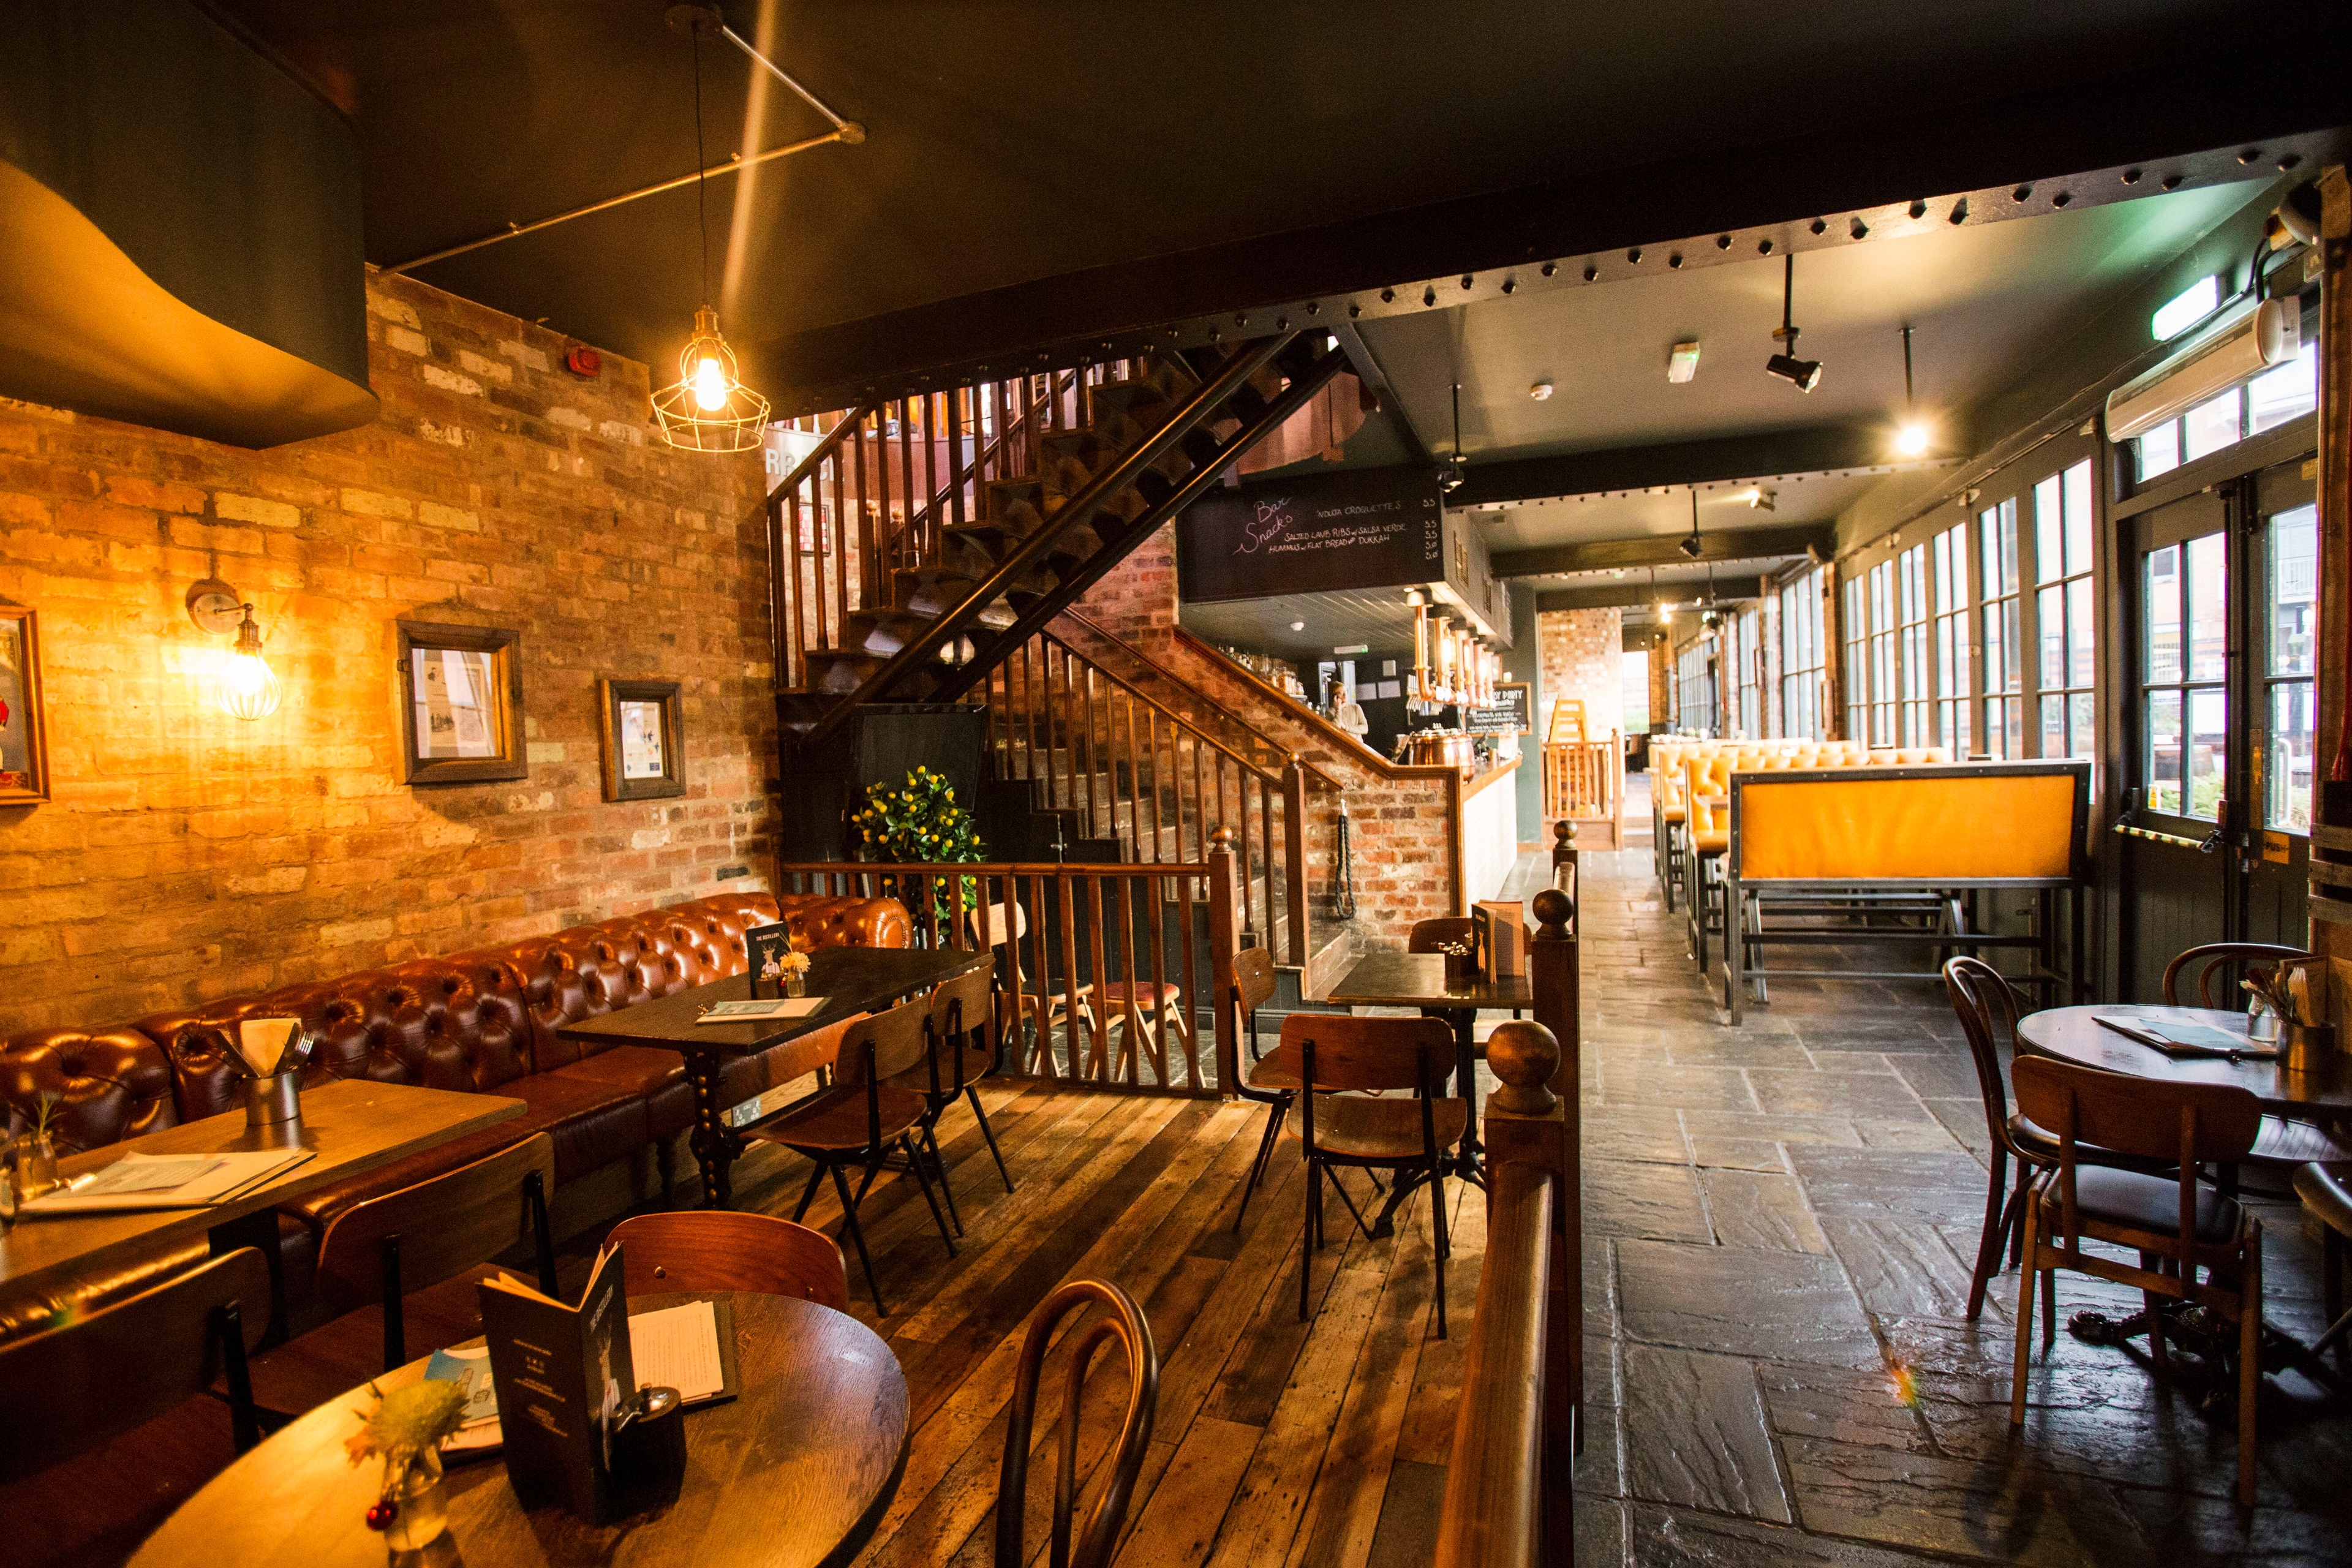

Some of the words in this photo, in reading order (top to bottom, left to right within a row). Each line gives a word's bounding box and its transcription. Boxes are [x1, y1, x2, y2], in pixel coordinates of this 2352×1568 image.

[1254, 497, 1293, 522] Bar
[1232, 515, 1293, 555] Snacks
[1268, 543, 1300, 554] HUMMUS
[1325, 538, 1348, 548] BREAD
[1359, 533, 1390, 545] DUKKAH
[1284, 532, 1310, 542] SALTED
[1311, 530, 1331, 538] LAMB
[1332, 527, 1351, 537] RIBS
[1358, 526, 1381, 535] SALSA
[1382, 523, 1407, 532] VERDE
